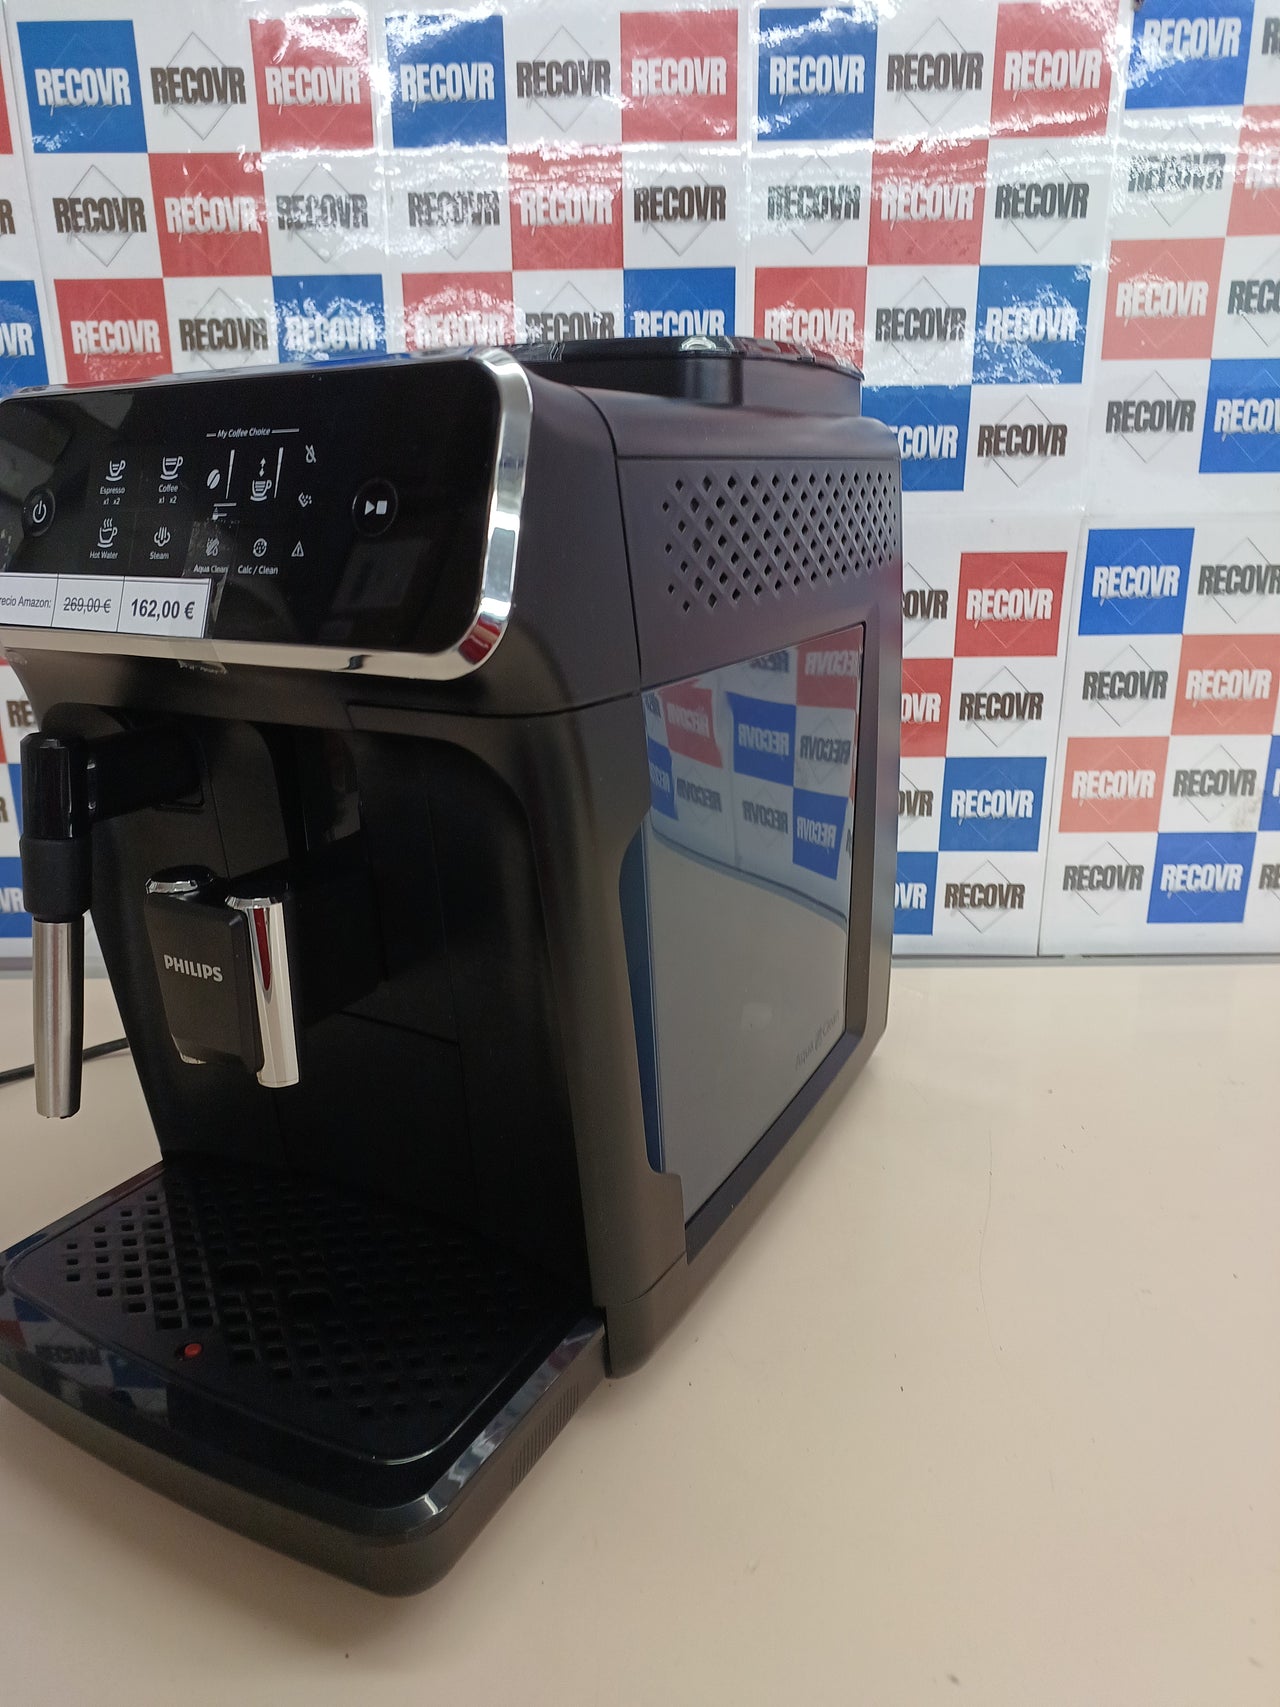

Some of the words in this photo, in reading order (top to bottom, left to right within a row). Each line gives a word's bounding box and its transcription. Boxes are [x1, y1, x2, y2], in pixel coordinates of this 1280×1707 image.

[1144, 17, 1242, 58] RECOVR
[34, 67, 131, 106] RECOVR
[150, 66, 246, 105] RECOVR
[265, 64, 360, 105] RECOVR
[401, 62, 494, 101] RECOVR
[516, 60, 611, 98] RECOVR
[631, 57, 727, 96] RECOVR
[769, 54, 866, 95] RECOVR
[887, 52, 984, 92] RECOVR
[1004, 49, 1101, 91] RECOVR
[53, 197, 146, 233] RECOVR
[165, 198, 259, 233] RECOVR
[277, 194, 368, 231] RECOVR
[520, 188, 613, 226] RECOVR
[634, 185, 726, 223] RECOVR
[767, 185, 861, 221] RECOVR
[881, 183, 975, 222] RECOVR
[995, 182, 1090, 219] RECOVR
[1115, 280, 1209, 319] RECOVR
[70, 319, 161, 354] RECOVR
[179, 318, 269, 352] RECOVR
[635, 309, 724, 338] RECOVR
[764, 309, 855, 343] RECOVR
[876, 307, 967, 342] RECOVR
[986, 307, 1078, 343] RECOVR
[217, 429, 227, 439] My
[228, 428, 248, 438] Coffee
[249, 427, 271, 437] Choice
[1105, 400, 1197, 434] RECOVR
[890, 425, 958, 459] COVR
[977, 423, 1068, 458] RECOVR
[100, 486, 125, 495] Espresso
[158, 484, 178, 493] Coffee
[90, 550, 100, 559] Hot
[101, 551, 118, 559] Water
[150, 551, 169, 560] Steam
[193, 564, 209, 574] Aqua
[237, 565, 251, 574] Calc
[258, 565, 279, 575] Clean
[1092, 564, 1181, 599] RECOVR
[18, 596, 51, 608] Amazon:
[131, 599, 180, 622] 162,00
[184, 601, 195, 619] €
[903, 590, 948, 619] OVR
[966, 588, 1053, 621] RECOVR
[1082, 670, 1169, 700] RECOVR
[1185, 669, 1272, 701] RECOVR
[959, 691, 1044, 722] RECOVR
[1071, 769, 1157, 800] RECOVR
[1172, 769, 1258, 798] RECOVR
[950, 789, 1034, 819] RECOVR
[1062, 864, 1145, 892] RECOVR
[1160, 864, 1244, 893] RECOVR
[944, 882, 1025, 910] RECOVR
[163, 954, 223, 983] PHILIPS
